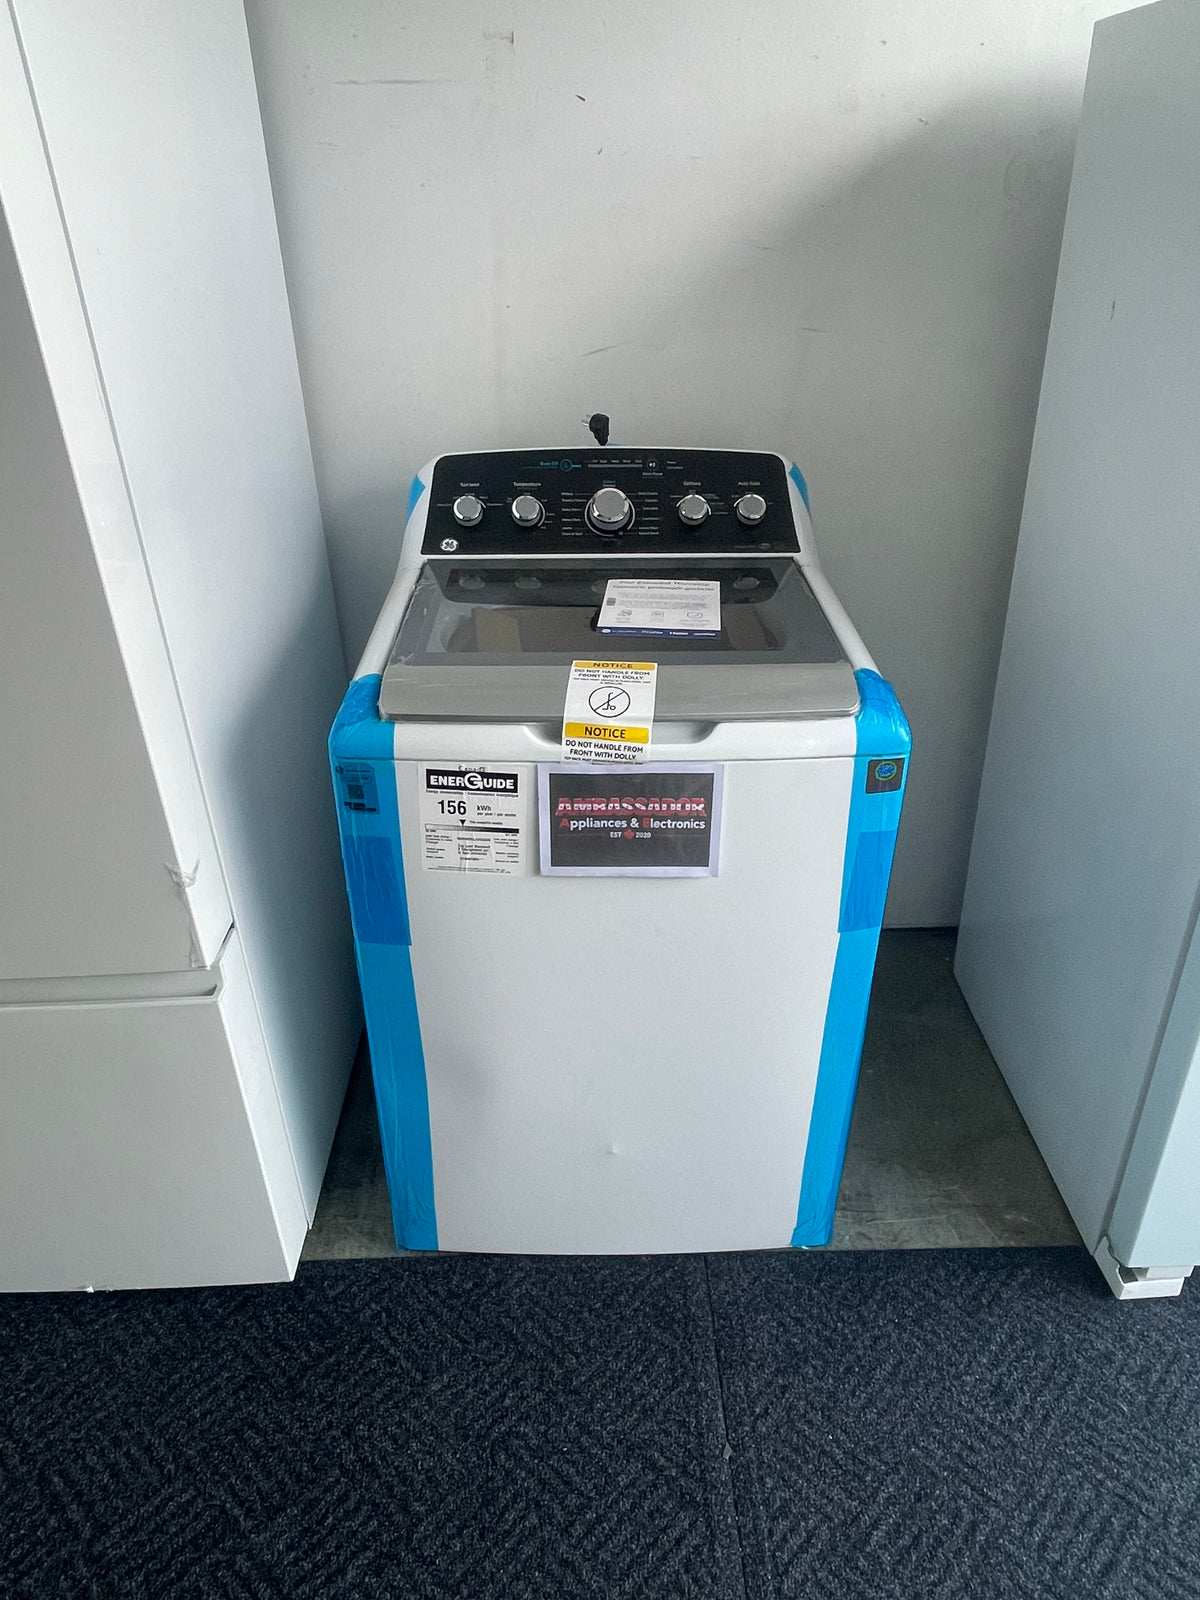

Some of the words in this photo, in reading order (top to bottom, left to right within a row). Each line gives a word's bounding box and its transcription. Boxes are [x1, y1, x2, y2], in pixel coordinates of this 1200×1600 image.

[584, 726, 626, 739] NOTICE
[565, 739, 576, 747] DO
[577, 741, 593, 749] NOT
[593, 742, 622, 751] HANDLE
[623, 745, 644, 753] FROM
[569, 748, 593, 757] FRONT
[593, 750, 613, 759] WITH
[429, 772, 515, 790] ENERGUIDE
[437, 799, 467, 815] 156
[555, 797, 707, 816] AMBASSADOR
[559, 817, 627, 830] Appliances
[630, 817, 639, 828] &
[642, 817, 706, 829] Electronics
[635, 831, 652, 839] 2020
